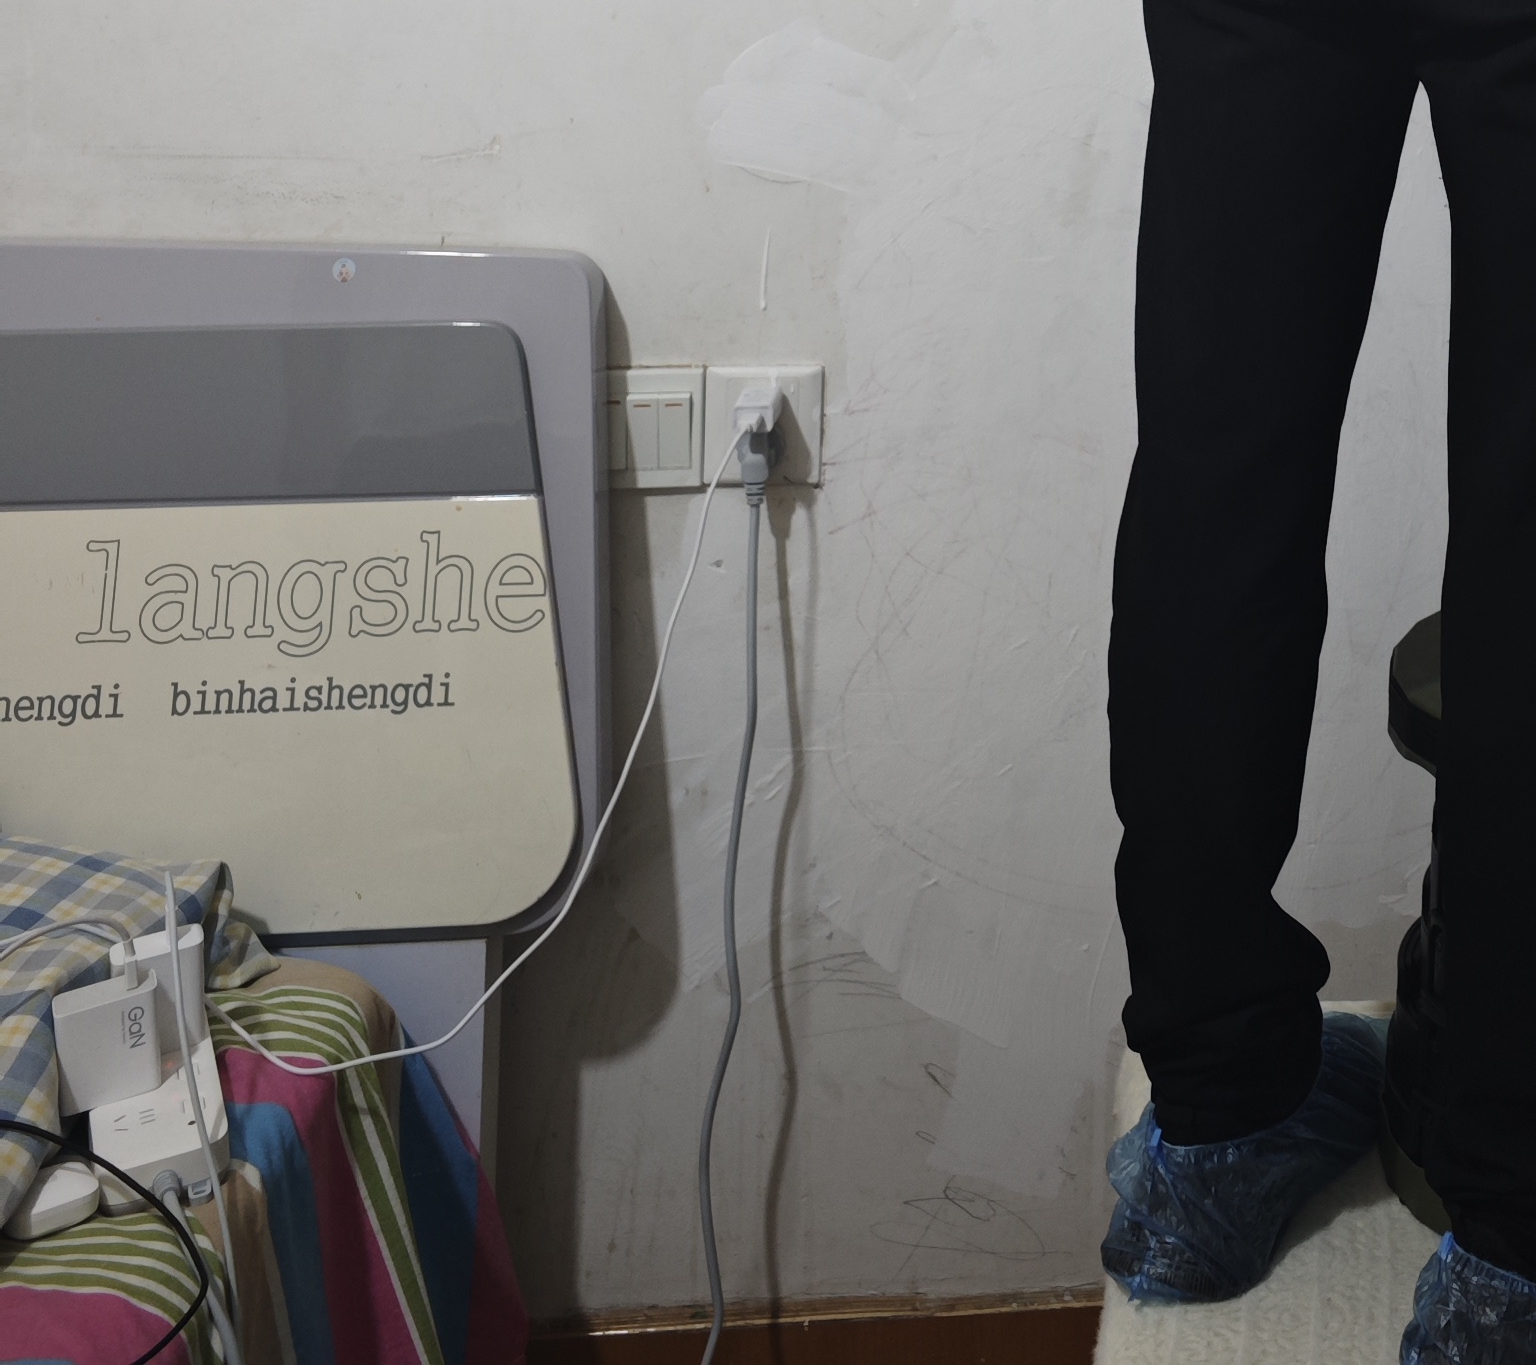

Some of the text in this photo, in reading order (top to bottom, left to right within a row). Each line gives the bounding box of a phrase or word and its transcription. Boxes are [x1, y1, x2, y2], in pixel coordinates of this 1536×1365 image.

[76, 530, 547, 658] langshe
[170, 672, 456, 718] binhaishengdi
[128, 1006, 147, 1049] GaN
